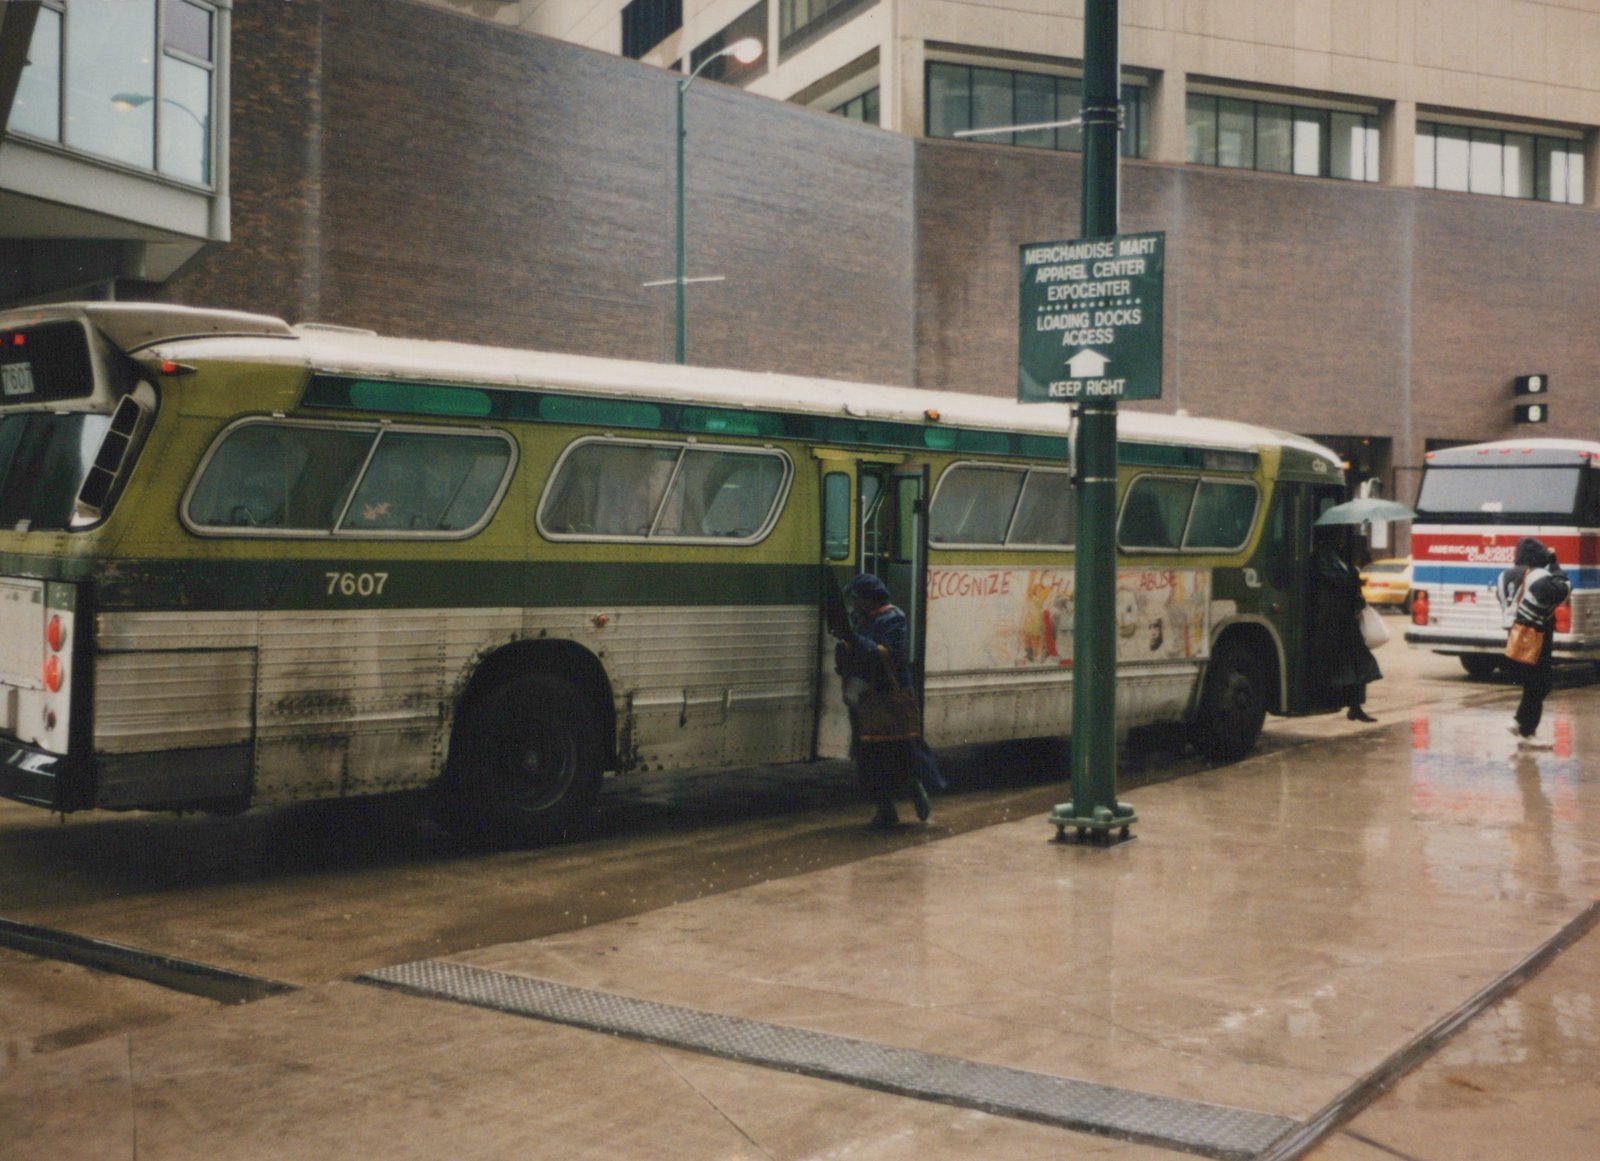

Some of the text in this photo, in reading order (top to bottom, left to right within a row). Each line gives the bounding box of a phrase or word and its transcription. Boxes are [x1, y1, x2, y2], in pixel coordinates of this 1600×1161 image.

[1025, 238, 1157, 264] MERCHANDISE MART
[1035, 259, 1146, 283] APPAREL CENTER
[1047, 280, 1131, 301] EXPOCENTER
[1037, 309, 1142, 331] LOADING DOCKS
[1062, 328, 1114, 346] ACCESS
[2, 366, 33, 390] 7607
[1049, 379, 1126, 397] KEEP RIGHT
[325, 572, 389, 596] 7607
[1139, 569, 1178, 592] ABUSE
